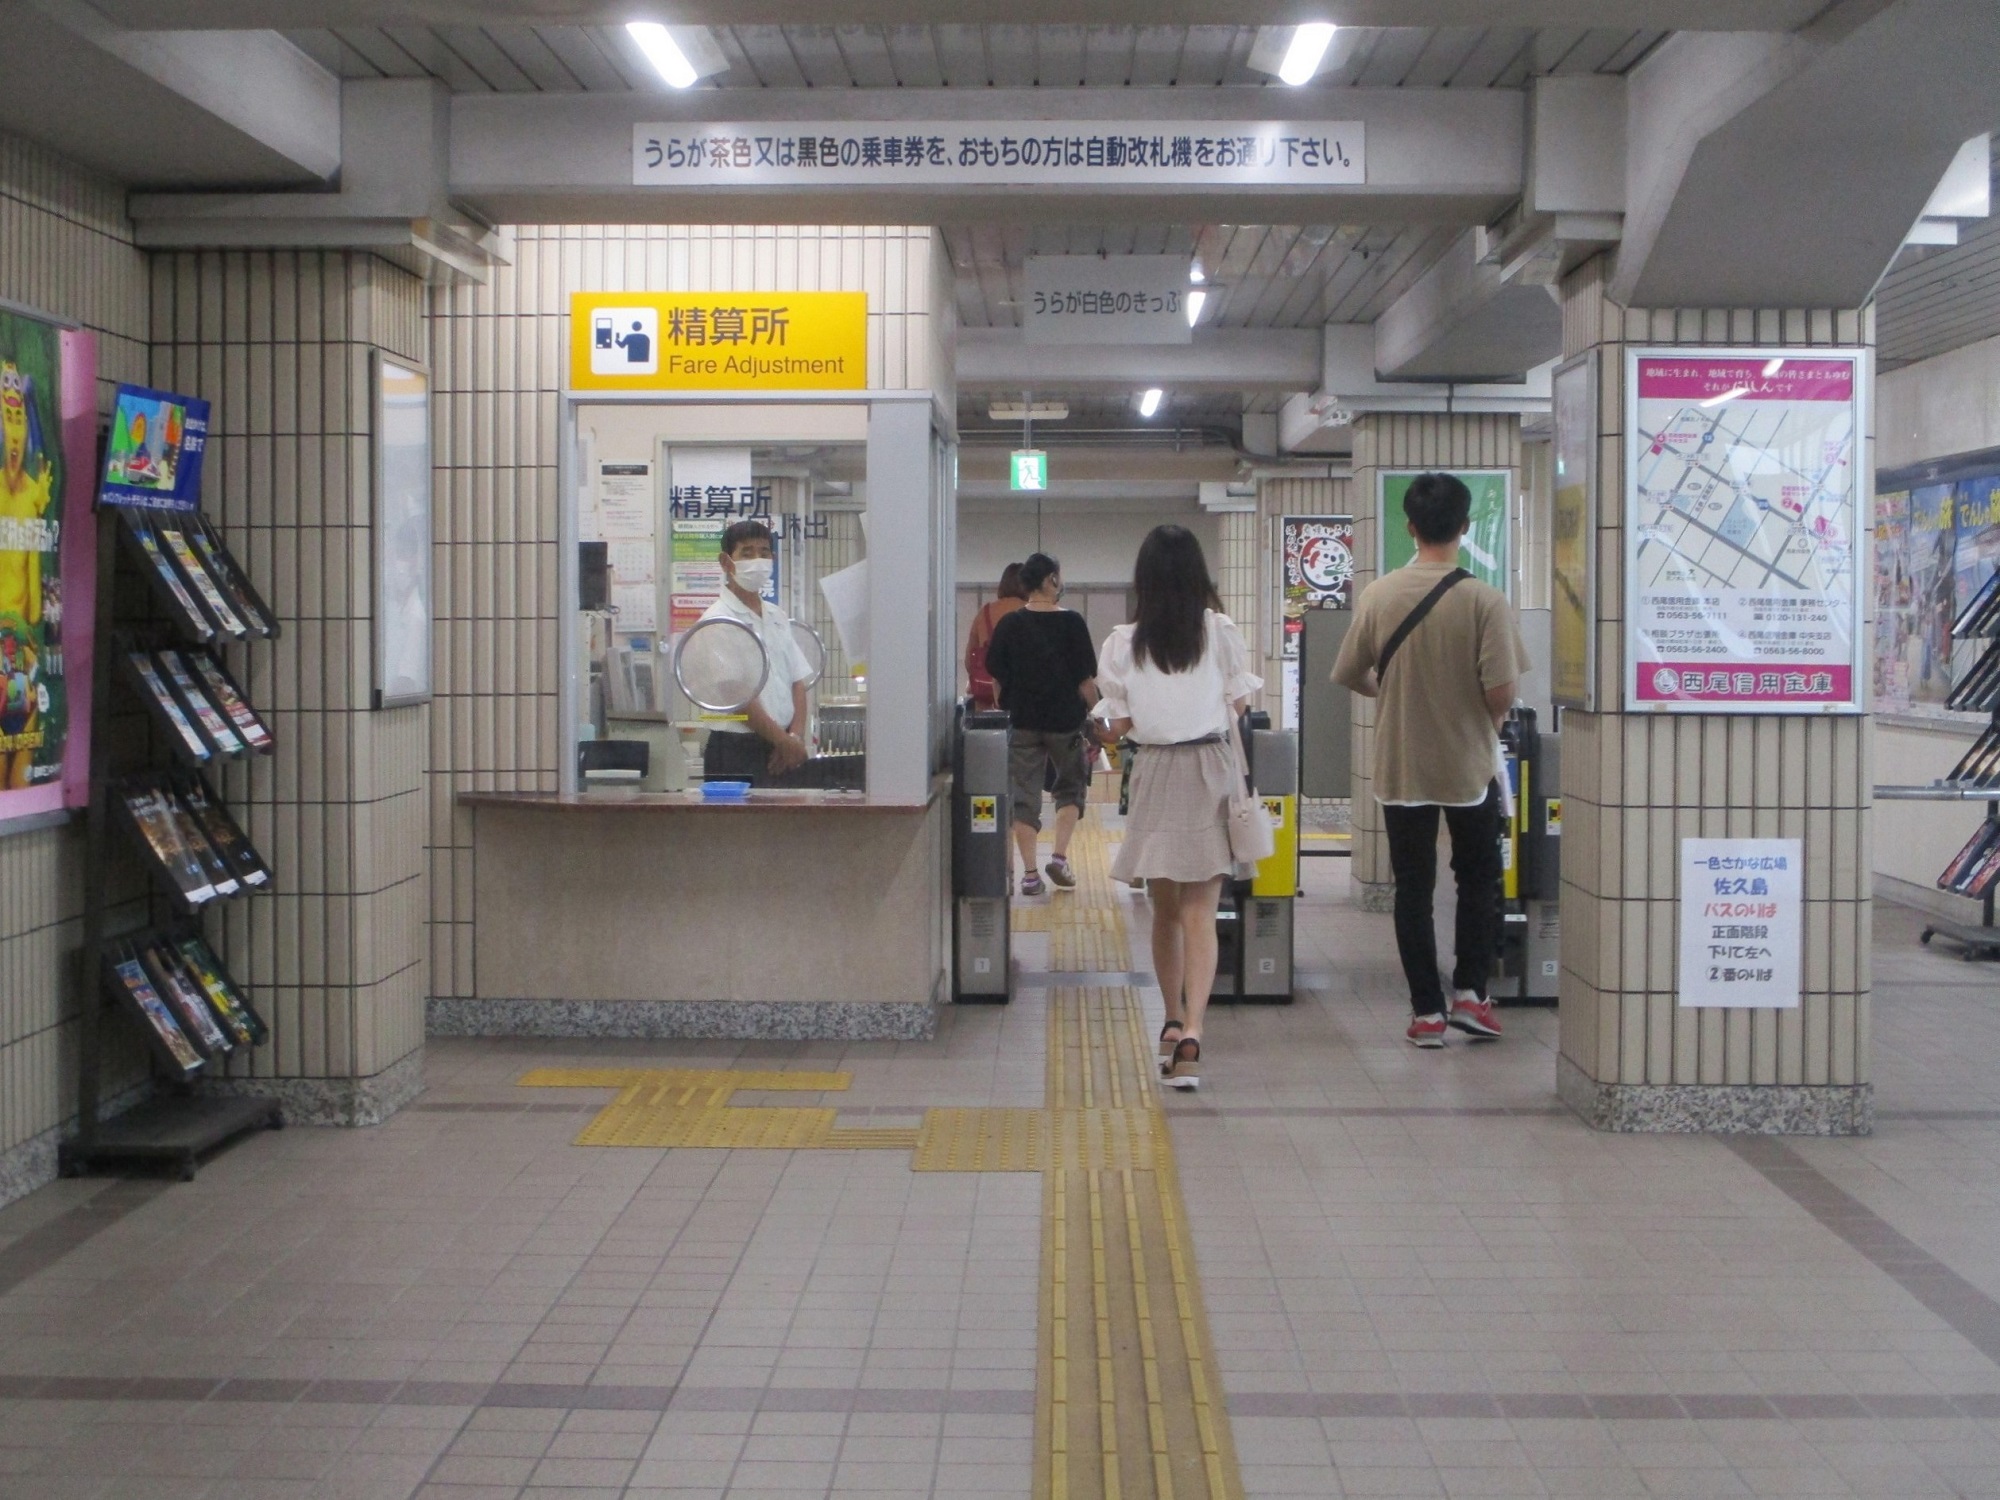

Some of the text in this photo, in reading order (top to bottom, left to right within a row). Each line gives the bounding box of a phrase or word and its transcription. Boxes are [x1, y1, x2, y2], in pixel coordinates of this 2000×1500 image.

[645, 136, 1351, 168] うらが茶色又は黒色の乗車券を、おもちの方は自動改札機をお通り下さい。
[1034, 290, 1182, 315] うらが白色のきっぷ
[668, 307, 789, 346] 精算所
[670, 355, 844, 378] Fare Adjustment
[669, 485, 772, 518] 精算所
[1683, 671, 1834, 695] 西尾信用金庫
[1694, 856, 1787, 870] 一色さかな広場
[1713, 877, 1768, 895] 佐久島
[1704, 903, 1777, 918] バスのりば
[1712, 925, 1768, 939] 正面階段
[1707, 945, 1772, 959] 下りて左へ
